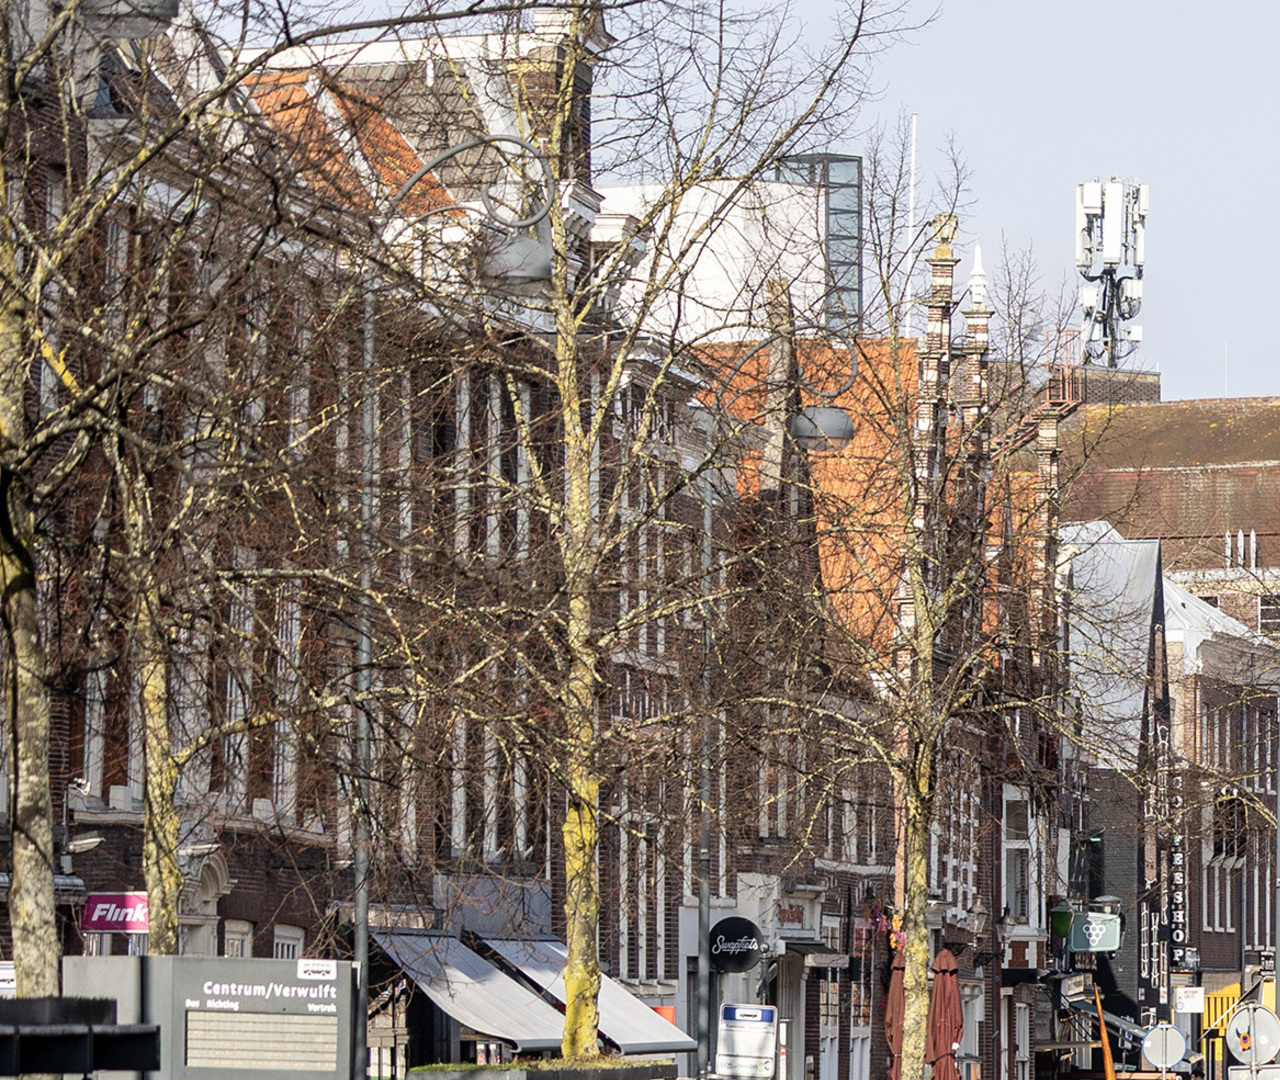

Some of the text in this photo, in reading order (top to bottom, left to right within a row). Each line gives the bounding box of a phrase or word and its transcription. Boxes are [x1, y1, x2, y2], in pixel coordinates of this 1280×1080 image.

[91, 902, 148, 922] Flink
[711, 935, 759, 955] Swapfiets
[203, 980, 338, 999] Centrum/Verwulft
